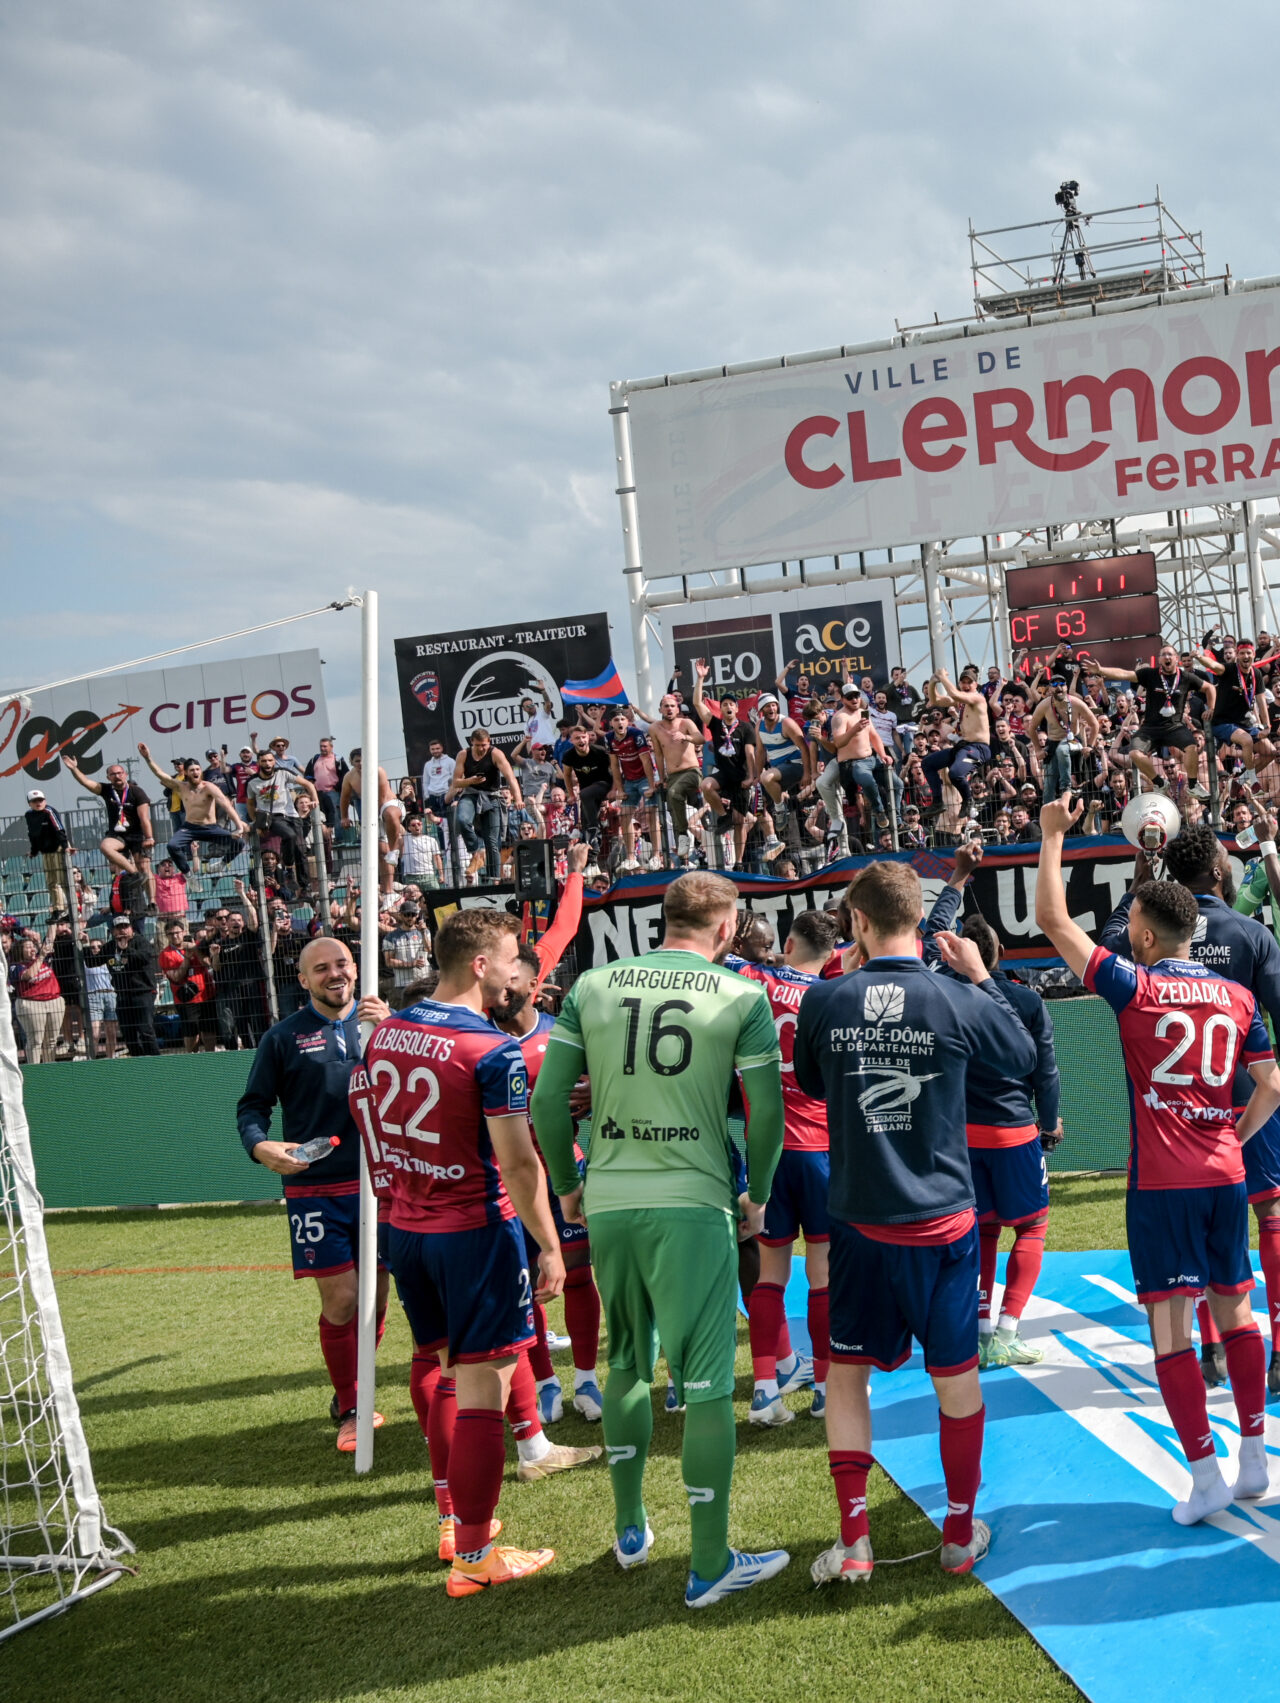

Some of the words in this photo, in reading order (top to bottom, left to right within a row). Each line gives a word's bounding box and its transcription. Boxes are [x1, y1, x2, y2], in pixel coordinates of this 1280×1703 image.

[845, 358, 949, 394] VILLE
[978, 346, 1021, 374] DE
[795, 617, 872, 654] ace
[1011, 614, 1040, 643] CF
[1055, 610, 1087, 638] 63
[416, 635, 505, 657] RESTAURANT
[516, 624, 587, 645] TRAITEUR
[690, 652, 762, 687] LEO
[800, 655, 872, 676] HÔTEL
[149, 685, 316, 734] CITEOS
[1189, 944, 1231, 957] E-DÔME
[607, 968, 721, 994] MARGUERON
[1157, 982, 1232, 1007] ZEDADKA
[373, 1027, 456, 1062] O.BUSQUETS
[618, 996, 695, 1077] 16
[831, 1026, 936, 1046] PUY-DE-DÔME
[831, 1042, 843, 1052] LE
[847, 1040, 935, 1056] DÉPARTEMENT
[1151, 1010, 1238, 1087] 20
[859, 1057, 892, 1066] VILLE
[896, 1058, 911, 1066] DE
[370, 1059, 441, 1144] 22
[865, 1114, 912, 1125] CLERMONT
[866, 1122, 912, 1133] FERRAND
[632, 1125, 700, 1142] BATIPRO
[374, 1174, 394, 1188] BAT
[291, 1211, 325, 1244] 25
[831, 1340, 864, 1351] PATRICK
